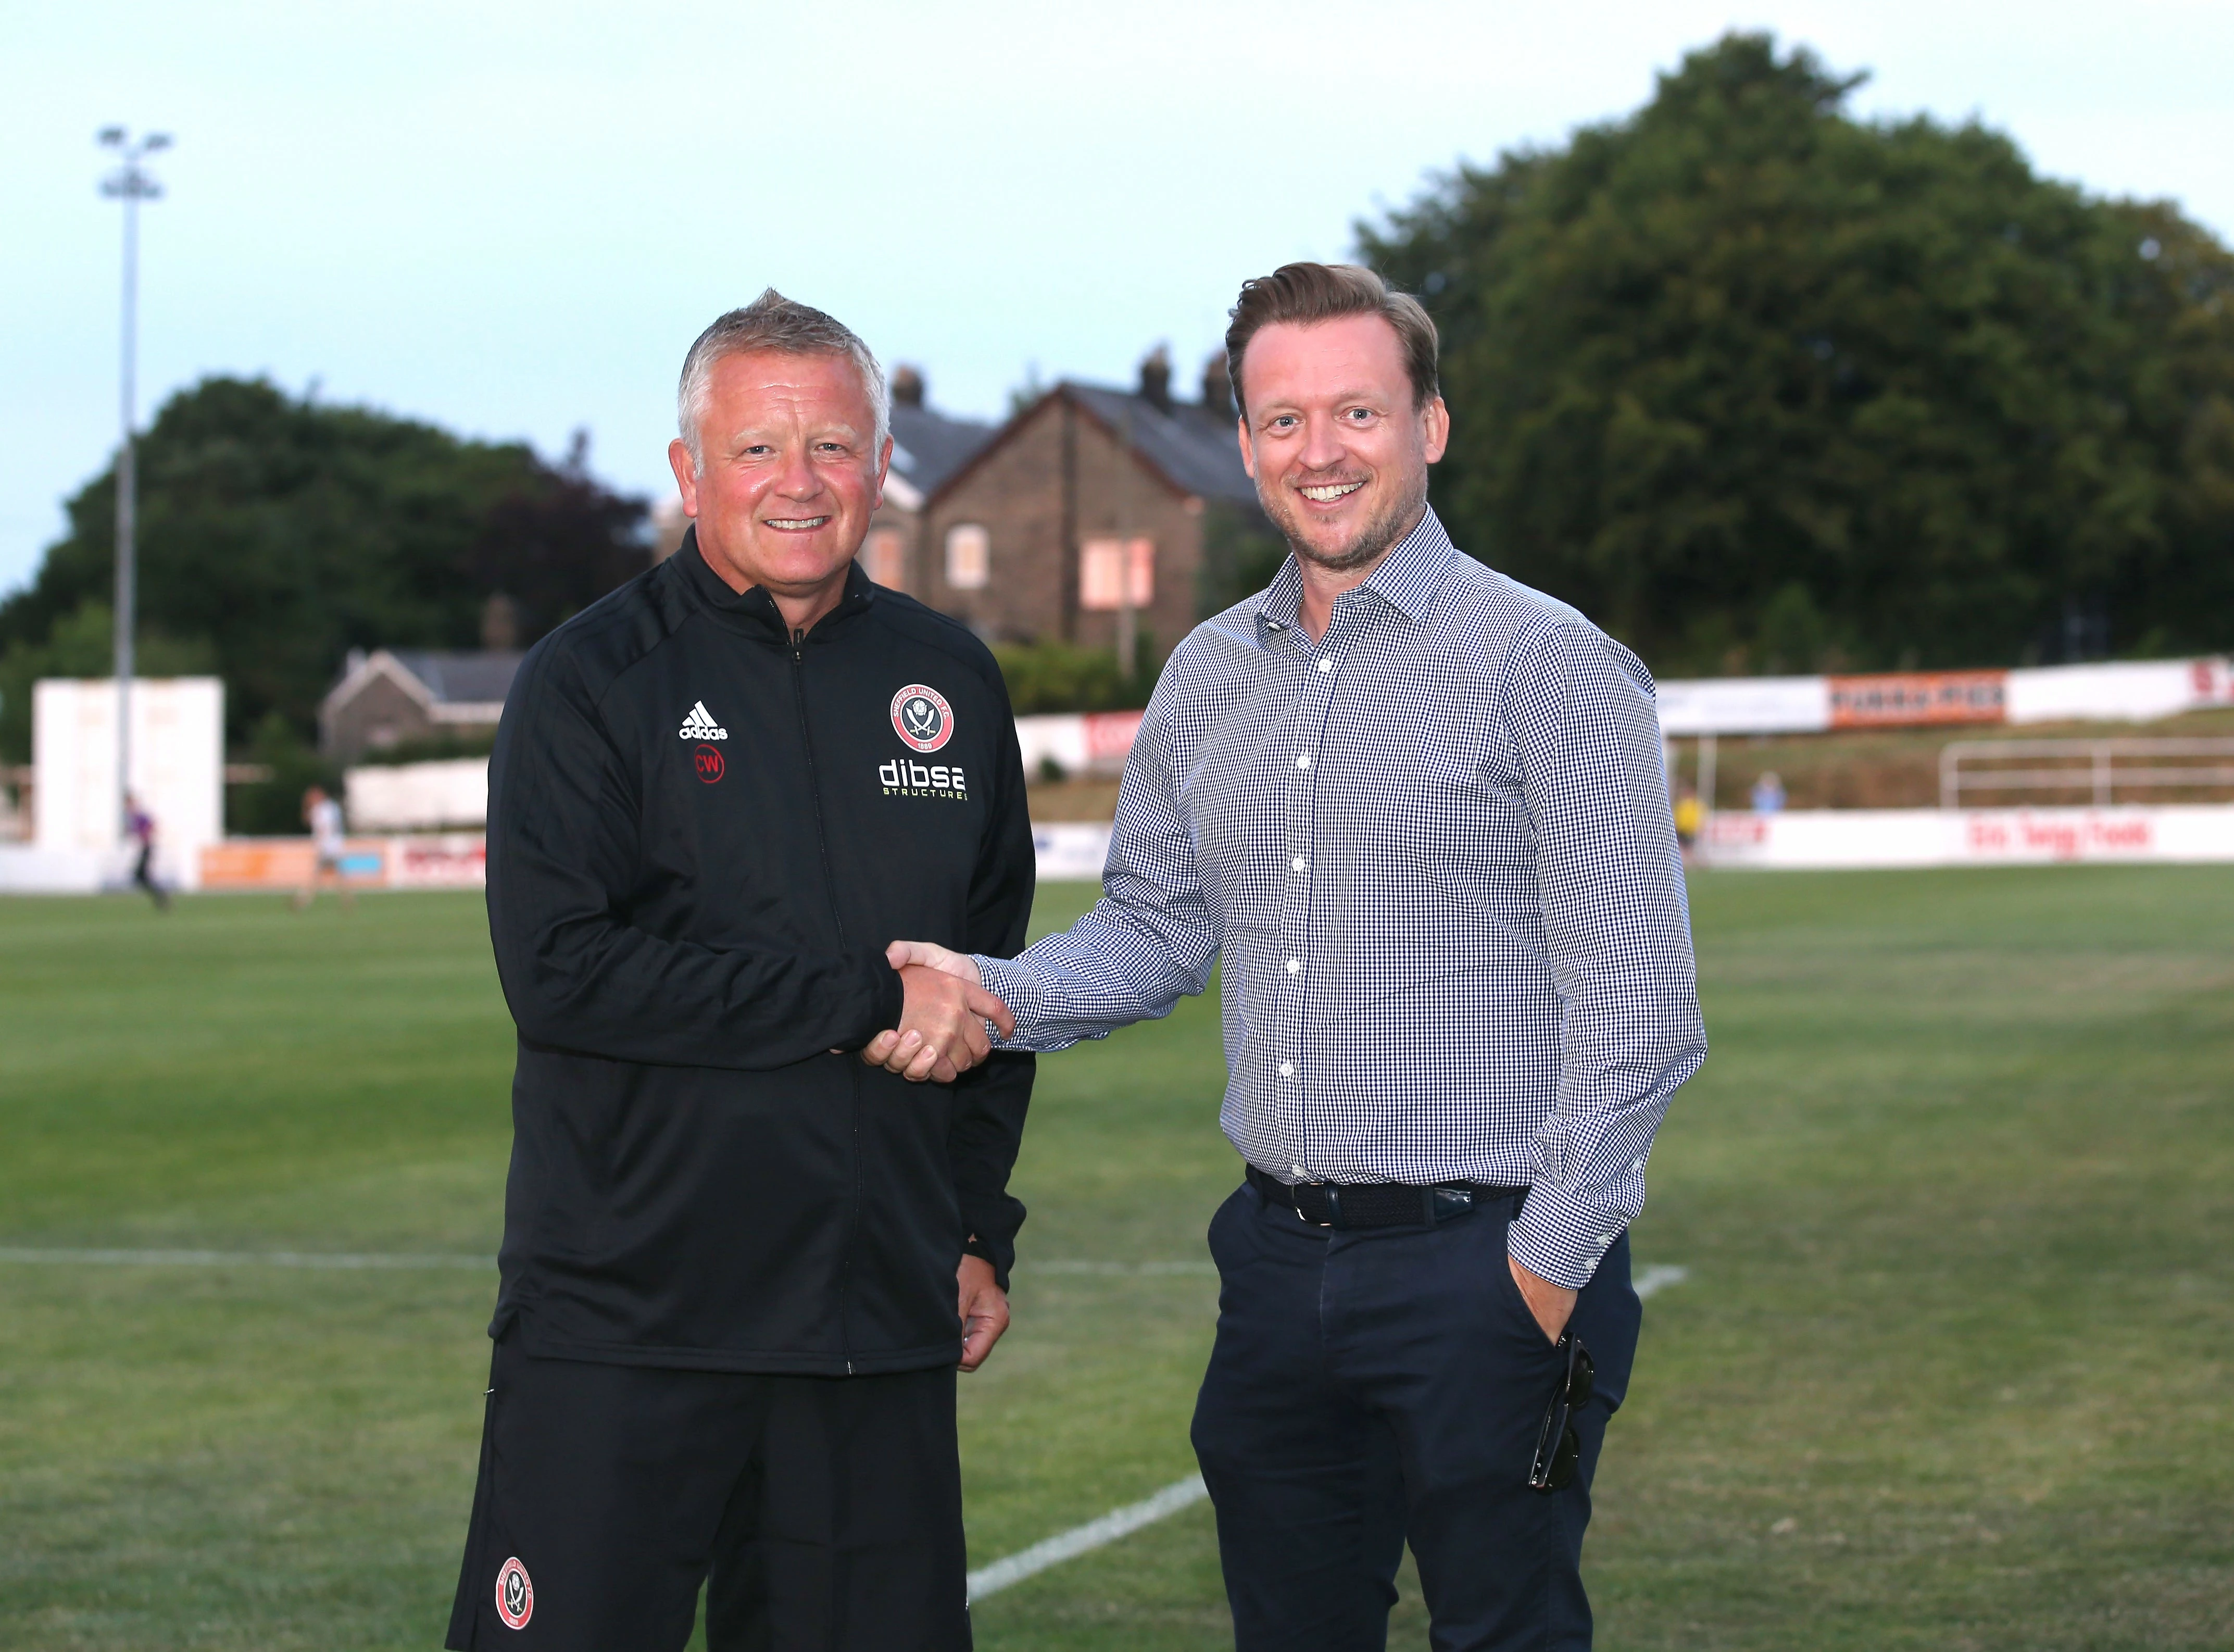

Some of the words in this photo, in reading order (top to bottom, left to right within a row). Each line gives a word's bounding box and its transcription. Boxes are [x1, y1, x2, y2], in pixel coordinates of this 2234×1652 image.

[894, 688, 917, 717] SHEFFIELD
[919, 688, 943, 705] UNITED
[679, 724, 728, 741] adidas
[696, 755, 719, 772] CW
